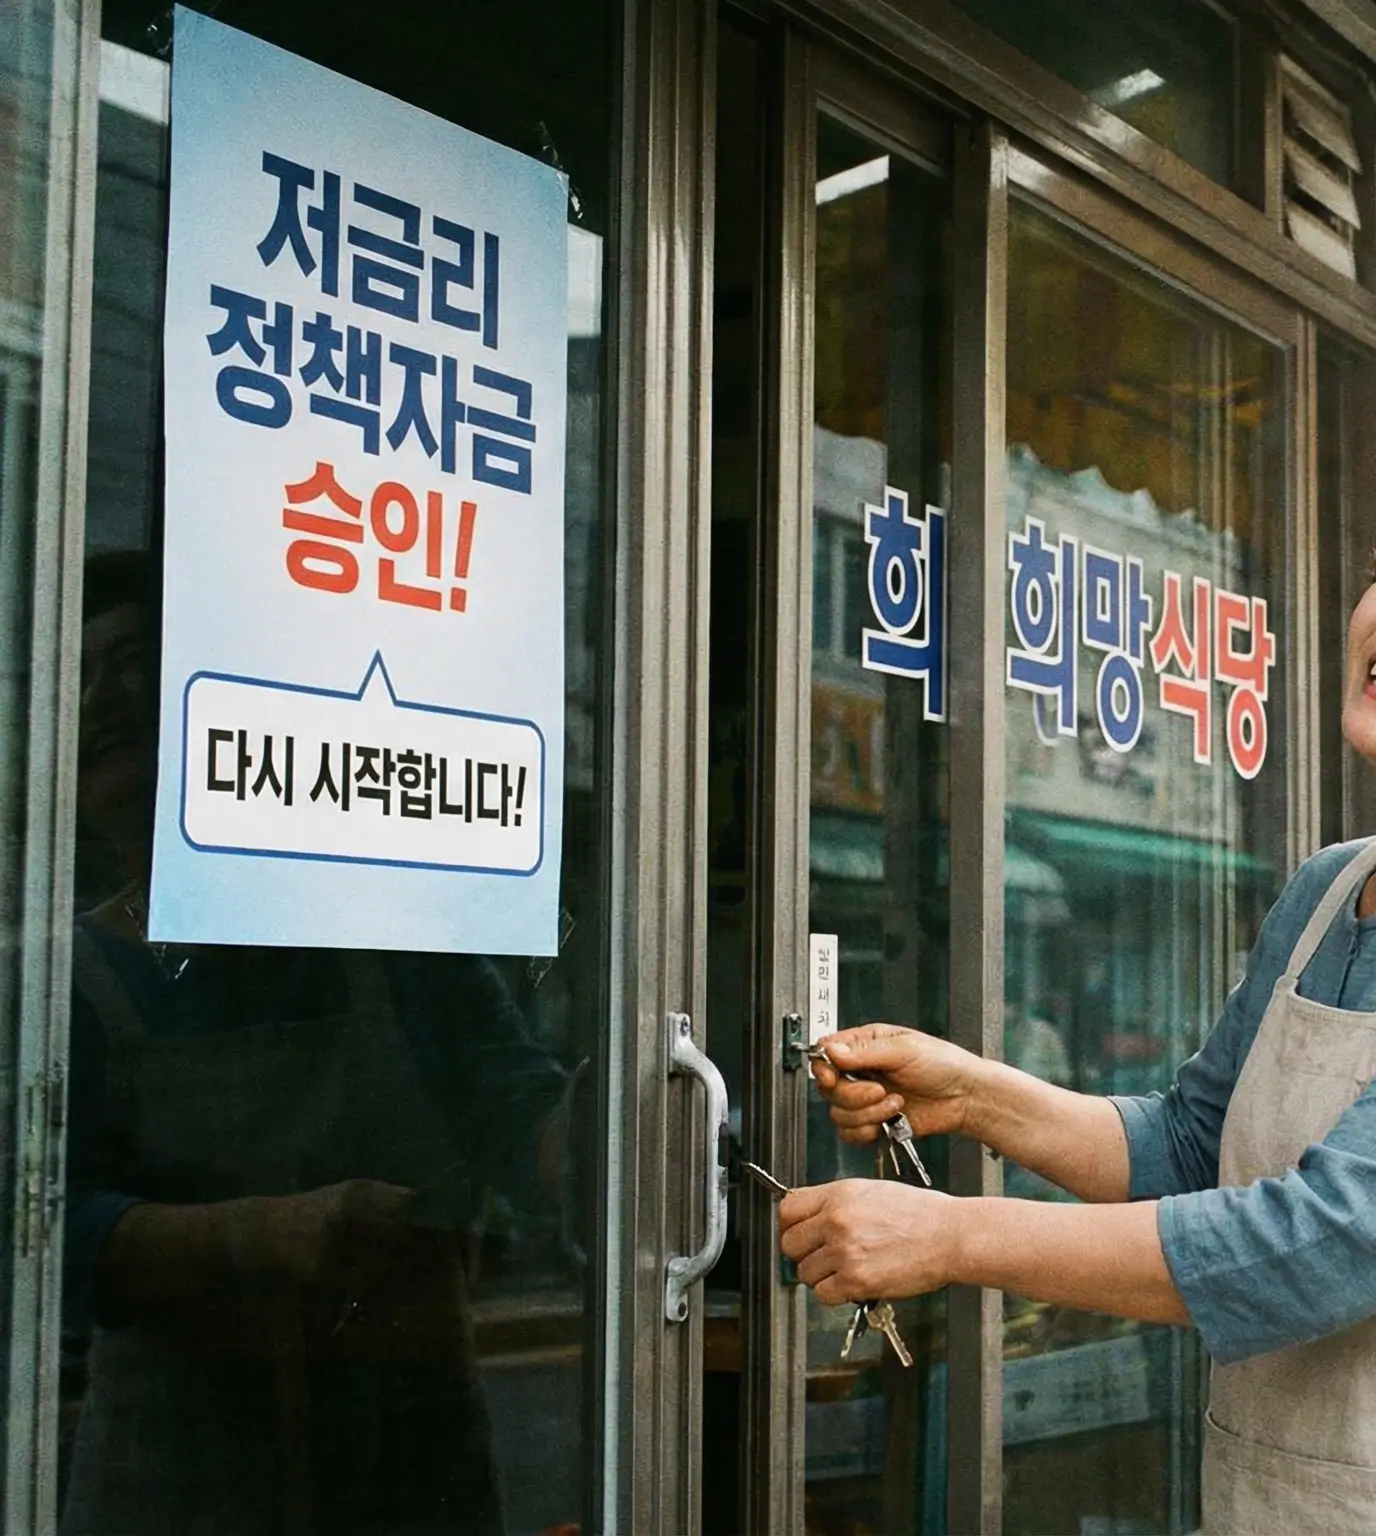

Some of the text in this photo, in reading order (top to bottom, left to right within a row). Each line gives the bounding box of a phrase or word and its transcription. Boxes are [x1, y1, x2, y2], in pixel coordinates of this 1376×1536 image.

[257, 150, 500, 349] 저금리
[206, 284, 537, 495] 정책자금
[281, 460, 478, 614] 승인!
[862, 486, 948, 723] 희
[1006, 514, 1276, 780] 희망식당
[207, 729, 527, 827] 다시 시작합니다!
